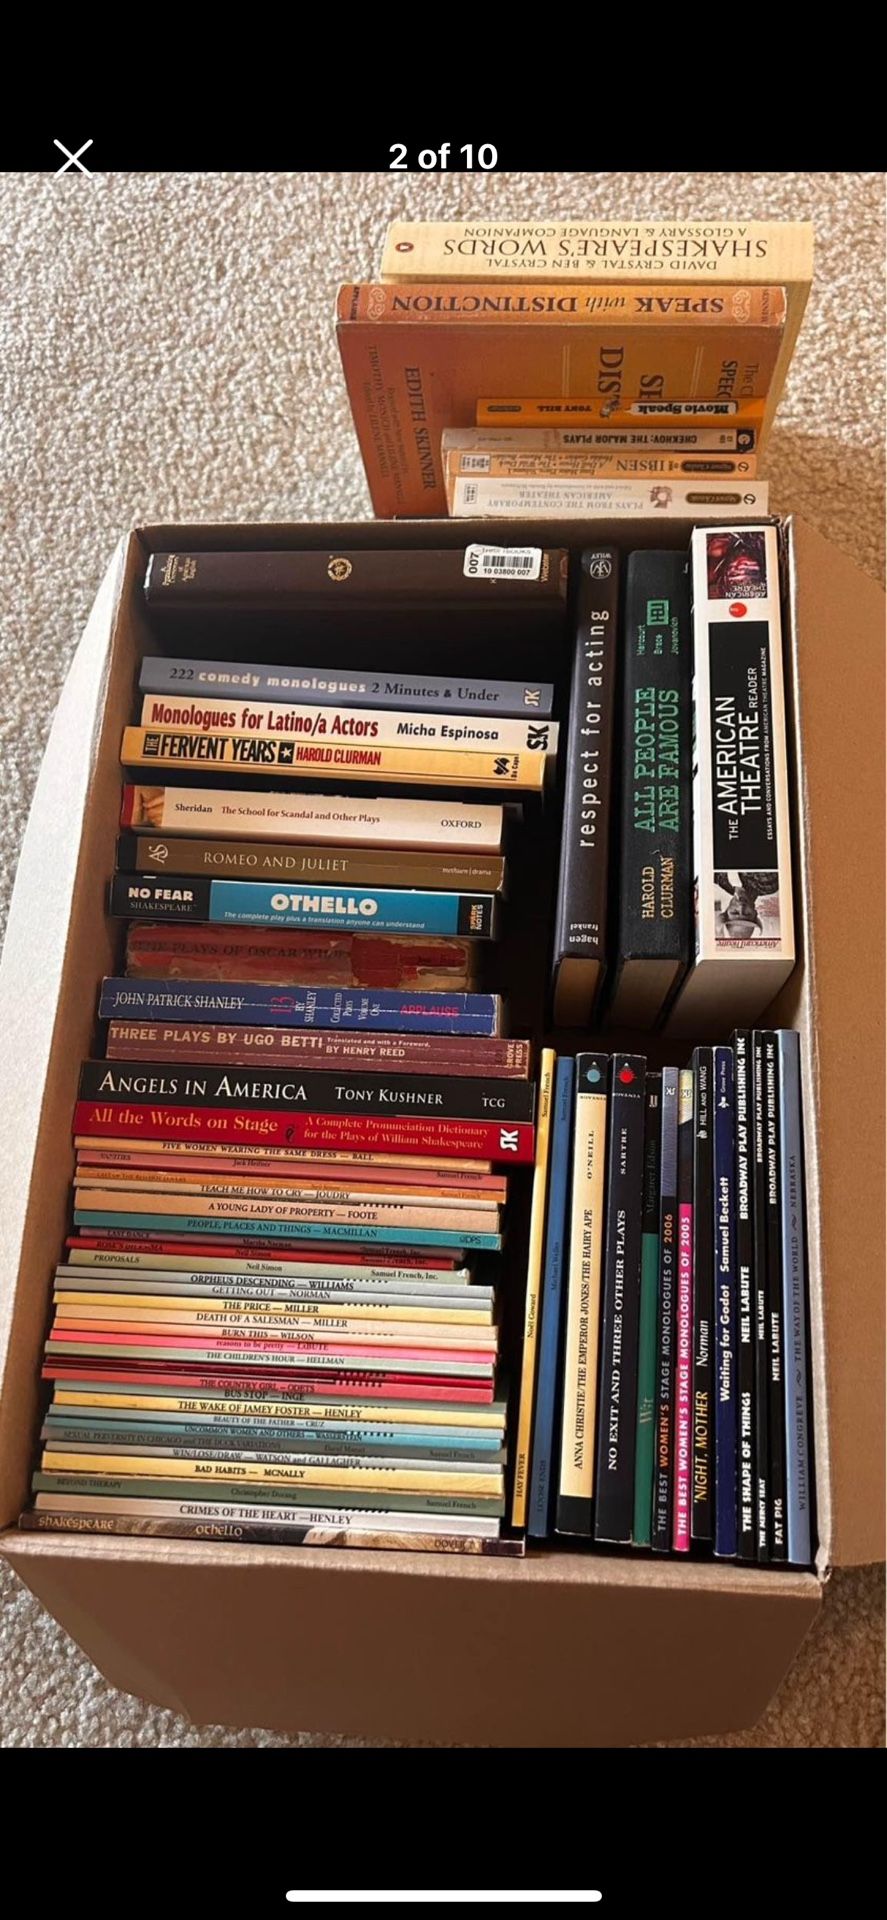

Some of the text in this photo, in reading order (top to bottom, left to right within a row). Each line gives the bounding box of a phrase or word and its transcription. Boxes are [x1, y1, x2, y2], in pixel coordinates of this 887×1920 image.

[464, 226, 746, 238] A GLOSSARY & LANGUAGE COMPANION
[443, 239, 768, 258] SHAKESPEARE'S WORDS
[487, 258, 717, 270] DAVID CRYSTAL & BEN CRYSTAL
[391, 294, 724, 313] SPEAK with DISTINCTION
[638, 404, 730, 414] Movie Speak
[405, 367, 436, 490] EDITH SKINNER
[563, 434, 697, 444] CHEKHOV: THE MAJOR PLAYS
[616, 460, 664, 472] IBSEN
[488, 499, 643, 510] PLAYS FROM THE CONTEMPORARY
[519, 490, 612, 499] AMERICAN THEATER
[468, 552, 480, 574] 007
[170, 667, 500, 701] 222 comedy monologues 2 Minutes & Under
[151, 702, 379, 738] Monologues for Latino/a Actors
[578, 610, 610, 847] respect for acting
[397, 721, 499, 742] Micha Espinosa
[740, 667, 762, 816] THEATRE READER
[145, 734, 159, 755] THE
[161, 733, 278, 764] FERVENT YEARS
[296, 745, 382, 766] HAROLD CLURMAN
[633, 687, 656, 832] ALL PEOPLE
[658, 688, 680, 832] ARE FAMOUS
[715, 695, 740, 840] THE AMERICAN
[174, 802, 381, 824] Sheridan The School for Scandal and Other Plays
[441, 818, 482, 830] OXFORD
[204, 851, 349, 872] ROMEO AND JULIET
[128, 886, 194, 901] NO FEAR
[641, 866, 655, 919] HAROLD
[660, 857, 674, 919] CLURMAN
[130, 901, 193, 912] SHAKESPEARE
[270, 893, 378, 916] OTHELLO
[113, 991, 245, 1010] JOHN PATRICK SHANLEY
[110, 1027, 323, 1048] THREE PLAYS BY UGO BETTI
[326, 1045, 406, 1057] BY HENRY REED
[482, 1096, 506, 1108] TCG
[89, 1107, 278, 1133] All the Words on Stage
[208, 1203, 378, 1220] A YOUNG LADY OF PROPERTY FOOTE
[719, 1176, 731, 1273] Samuel Beckett
[190, 1274, 354, 1291] ORPHEUS DESCENDING WILLIAMS
[223, 1301, 319, 1314] THE PRICE MILLER
[739, 1265, 751, 1343] NEIL LABUTE
[608, 1210, 625, 1471] NO EXIT AND THREE OTHER PLAYS
[695, 1320, 708, 1367] Norman
[719, 1284, 731, 1402] Waiting for Godot
[695, 1390, 708, 1503] 'NIGHT, MOTHER
[195, 1465, 305, 1479] BAD HABITS MCNALLY
[741, 1391, 752, 1532] THE SHAPE OF THINGS
[516, 1453, 526, 1498] HAY FEVER
[180, 1503, 352, 1525] CRIMES OF THE HEART HENLEY
